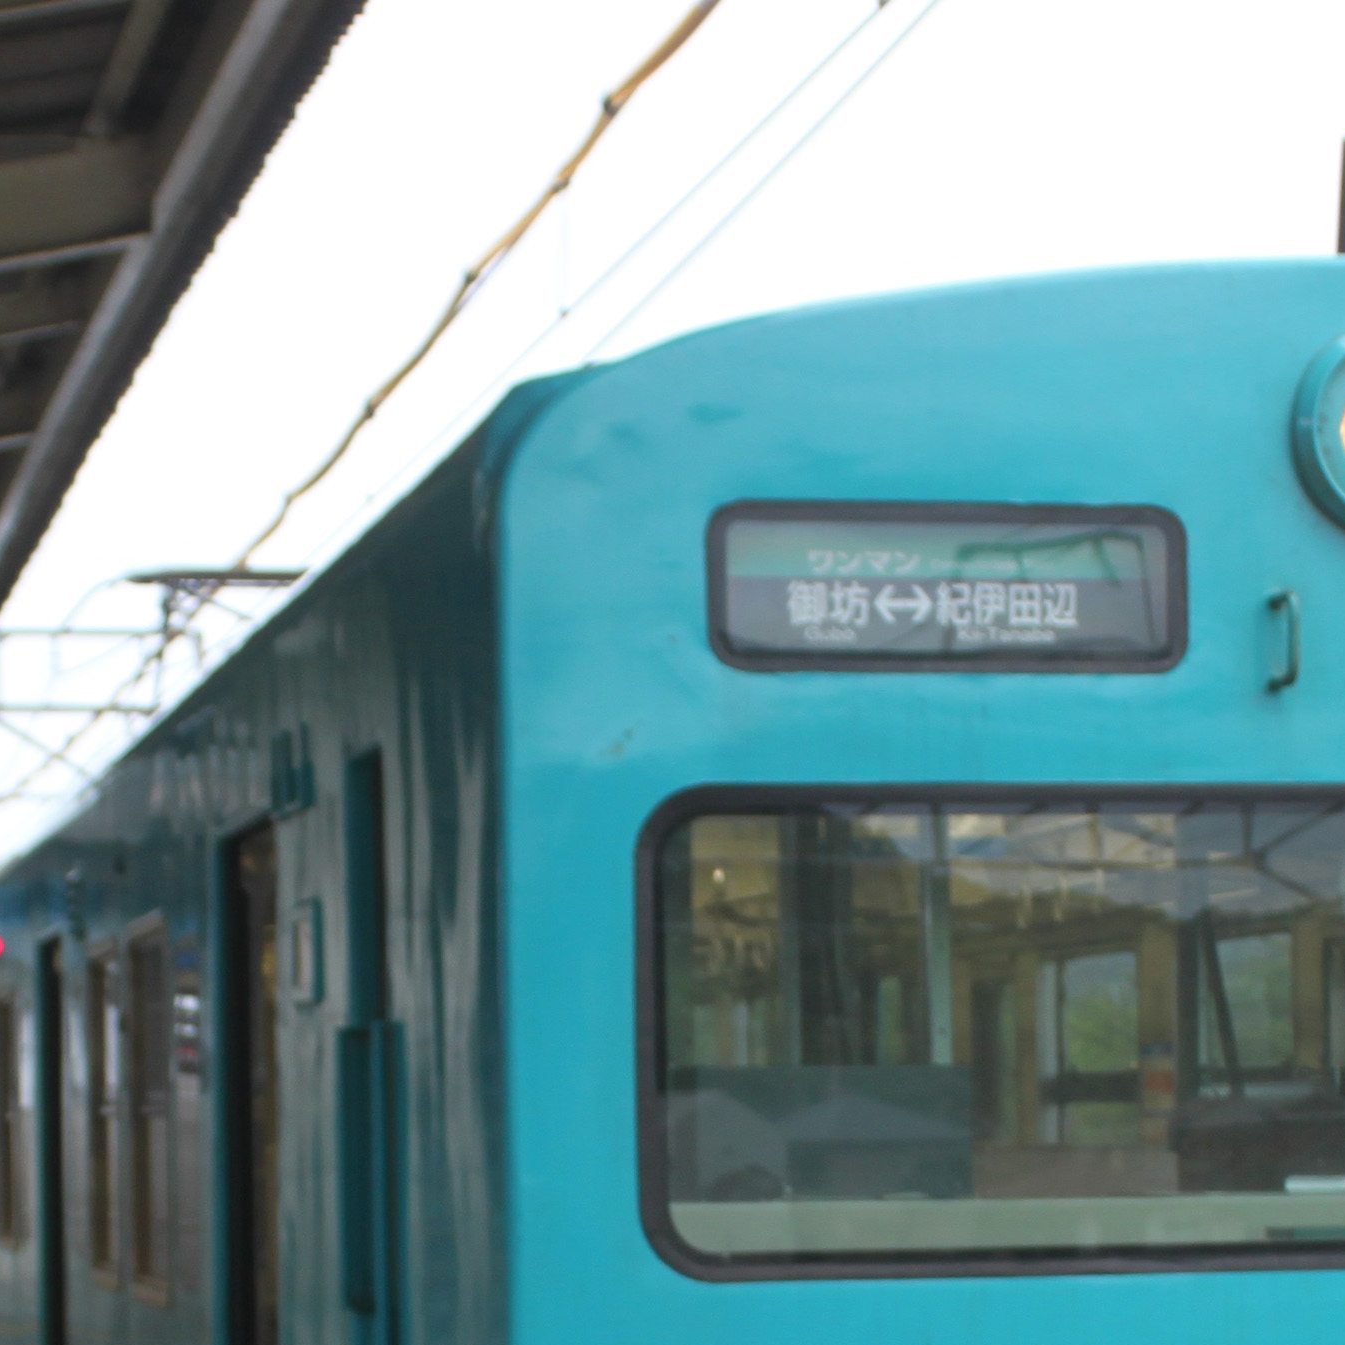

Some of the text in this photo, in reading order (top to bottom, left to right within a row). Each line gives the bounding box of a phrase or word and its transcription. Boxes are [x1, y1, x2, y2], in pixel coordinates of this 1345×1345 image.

[807, 550, 922, 574] ワンマン
[787, 579, 1078, 628] 御坊 紀伊田辺
